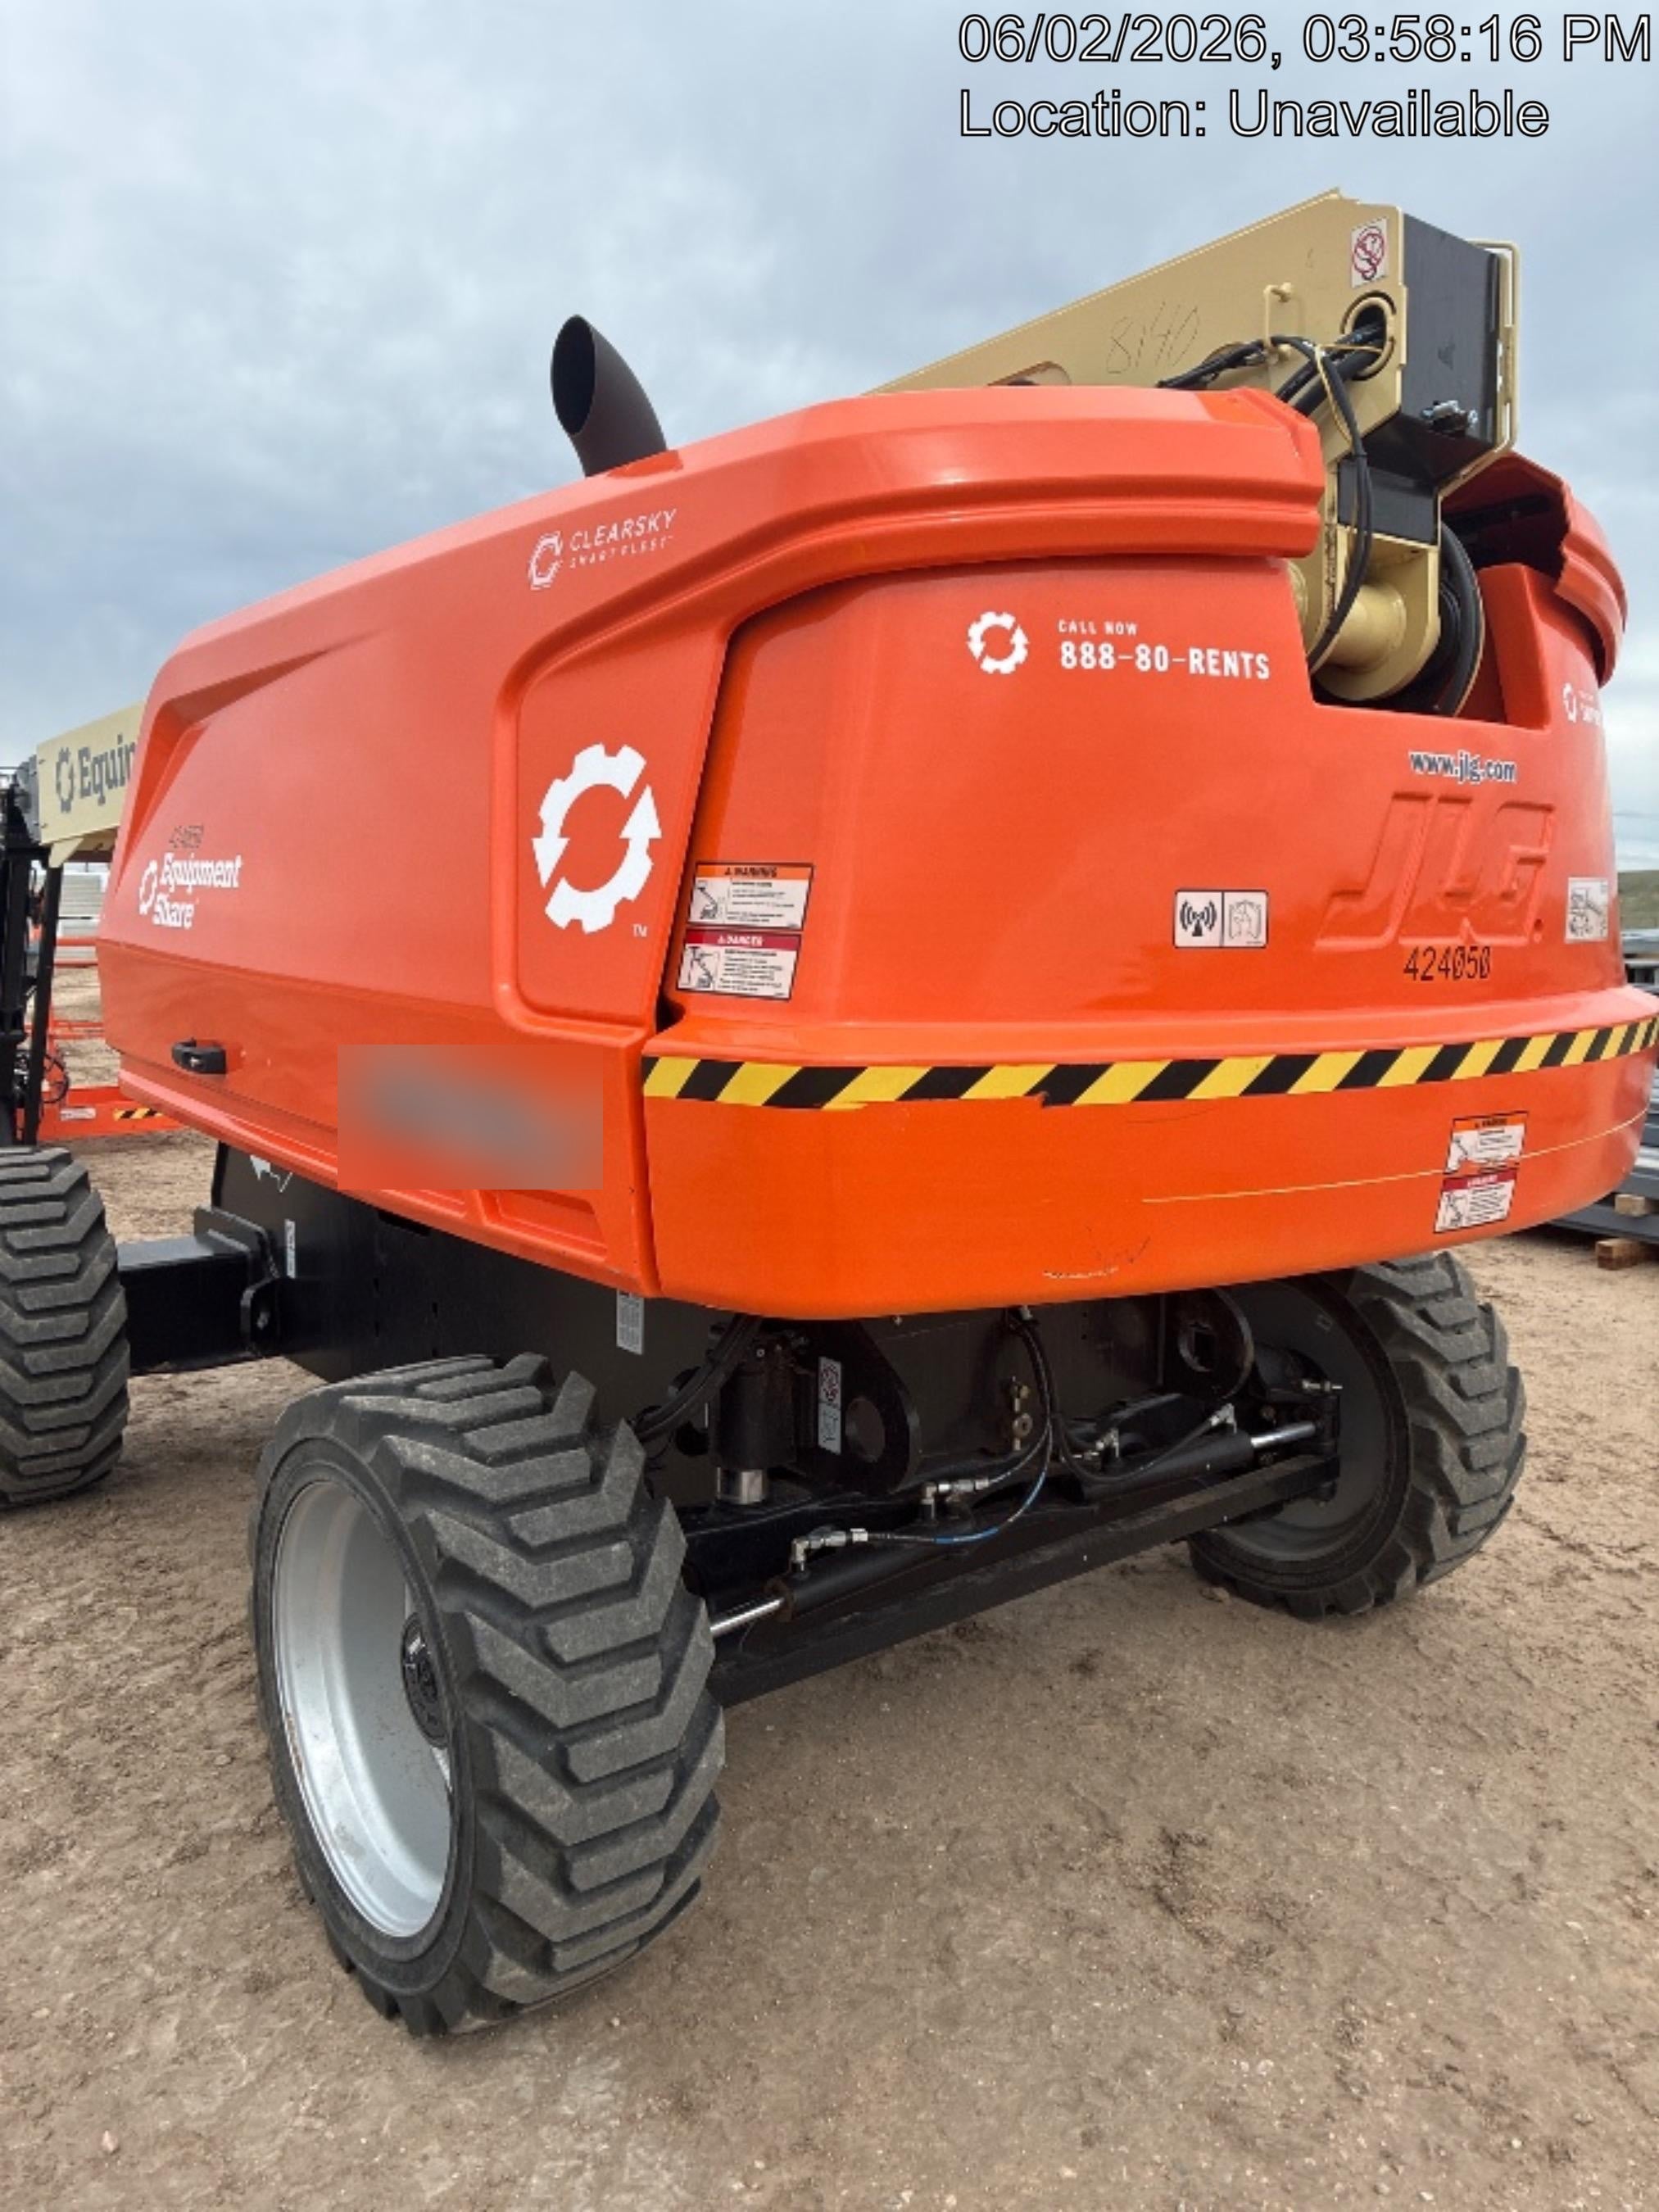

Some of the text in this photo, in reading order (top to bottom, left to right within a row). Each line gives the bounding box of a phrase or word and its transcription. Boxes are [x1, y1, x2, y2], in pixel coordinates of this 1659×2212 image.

[569, 508, 678, 551] CLEARSKY
[1058, 619, 1138, 637] CALL NOW
[1060, 641, 1270, 679] 888-80-RENTS
[1408, 750, 1518, 783] www.jlg.com
[159, 851, 243, 895] Equipment
[1314, 791, 1557, 950] JLG
[152, 892, 195, 929] Share
[1403, 945, 1491, 981] 424050
